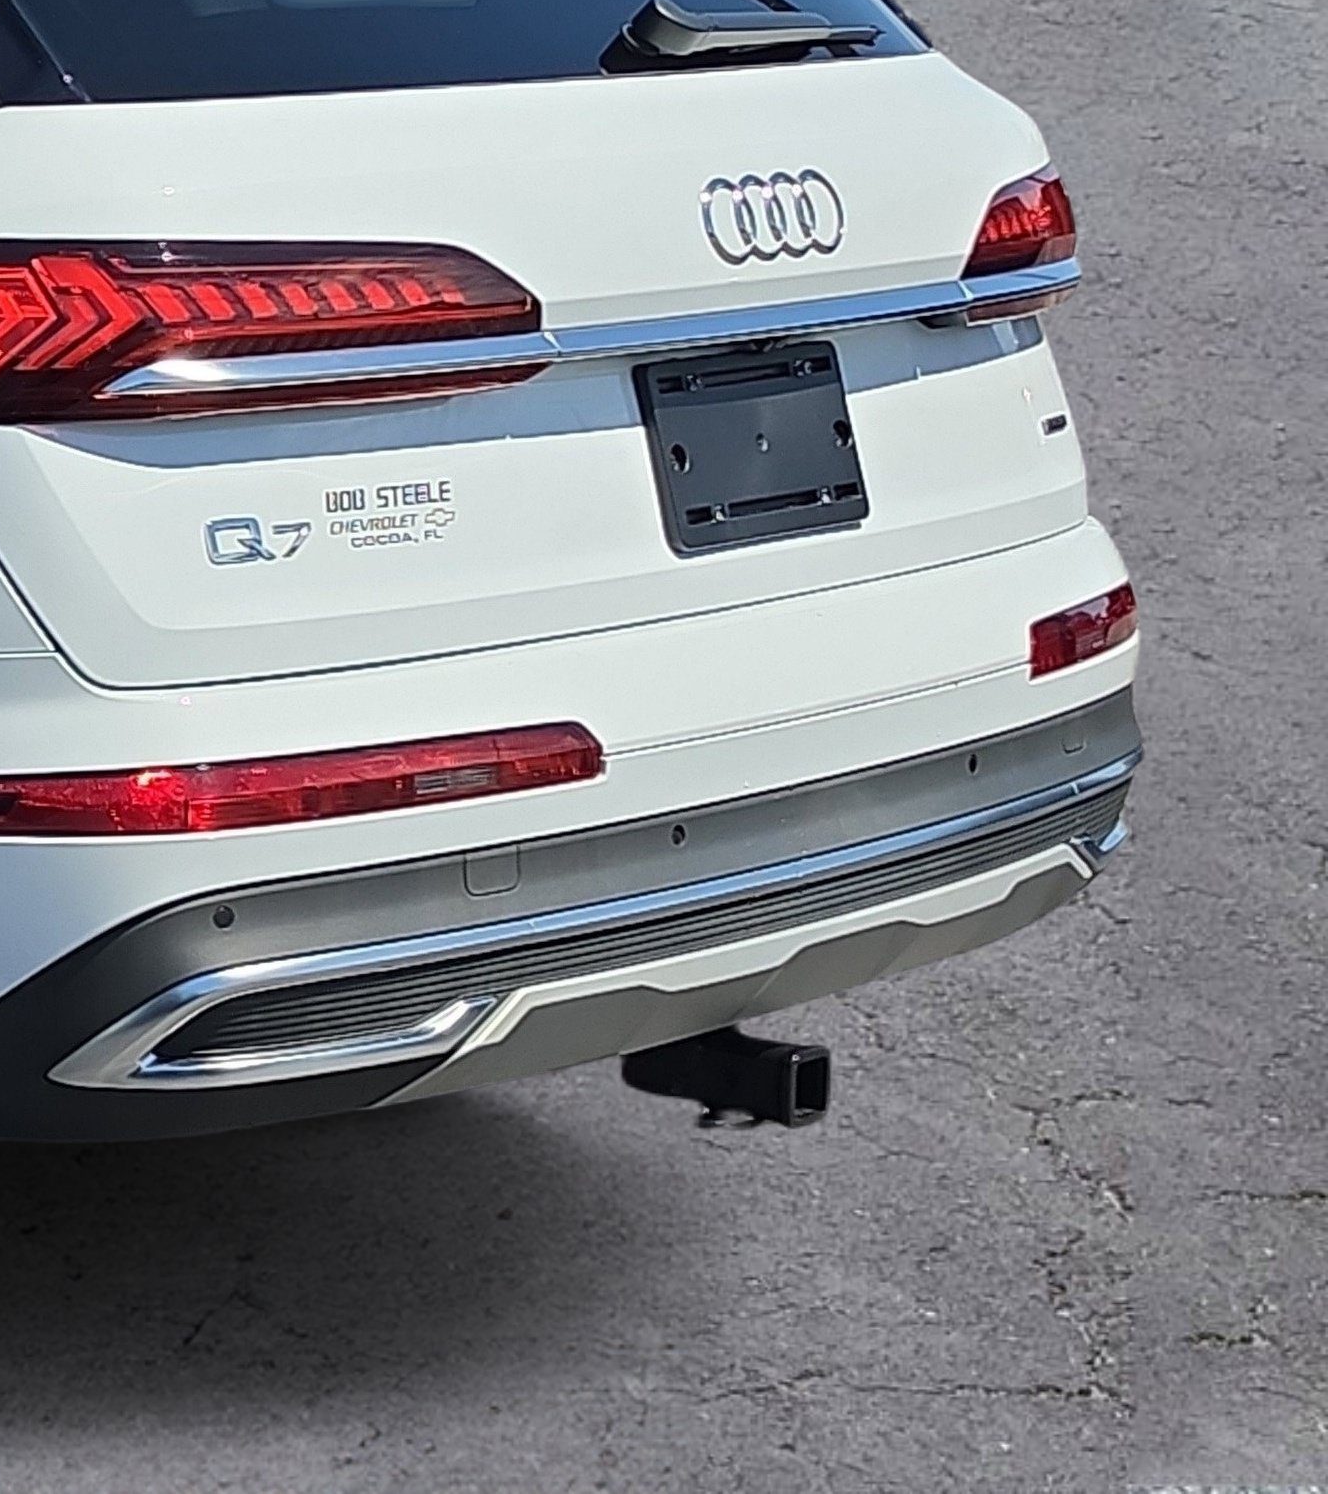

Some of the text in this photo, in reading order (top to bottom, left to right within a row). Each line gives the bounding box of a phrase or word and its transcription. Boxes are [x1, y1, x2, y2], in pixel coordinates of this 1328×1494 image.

[376, 480, 451, 508] STEELE
[330, 513, 418, 535] CHEVROLET
[204, 517, 312, 566] Q7
[351, 528, 444, 548] COCOA, FL
